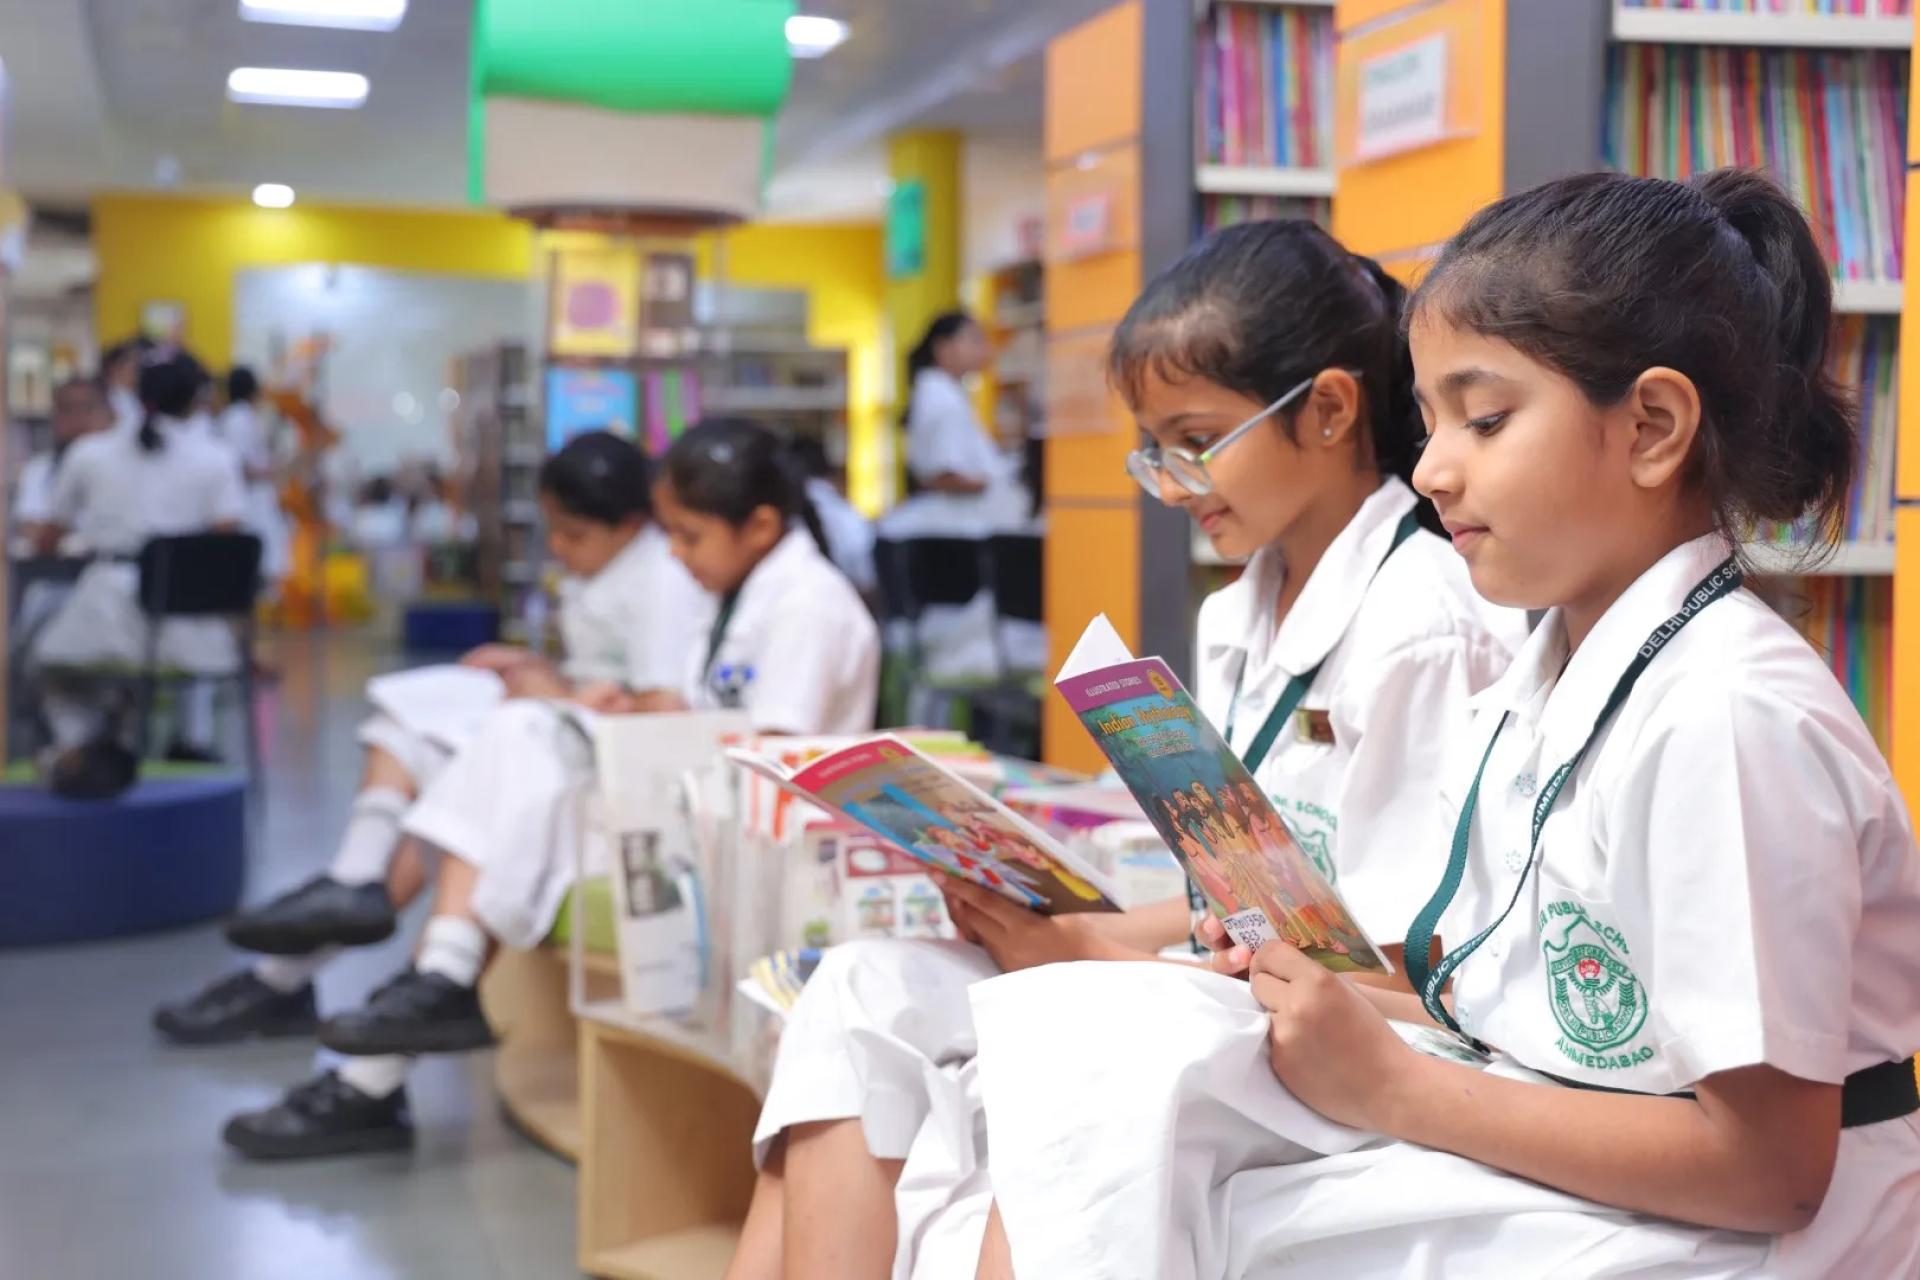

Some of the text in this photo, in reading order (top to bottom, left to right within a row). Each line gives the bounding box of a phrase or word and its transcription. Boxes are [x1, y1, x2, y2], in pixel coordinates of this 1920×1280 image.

[1638, 562, 1740, 659] DELHI PUBLIC SC
[1097, 711, 1137, 736] Indian
[1533, 765, 1571, 836] AHMEDA
[1425, 960, 1450, 1007] UBLIC
[1554, 1036, 1655, 1070] AHMEDABAD
